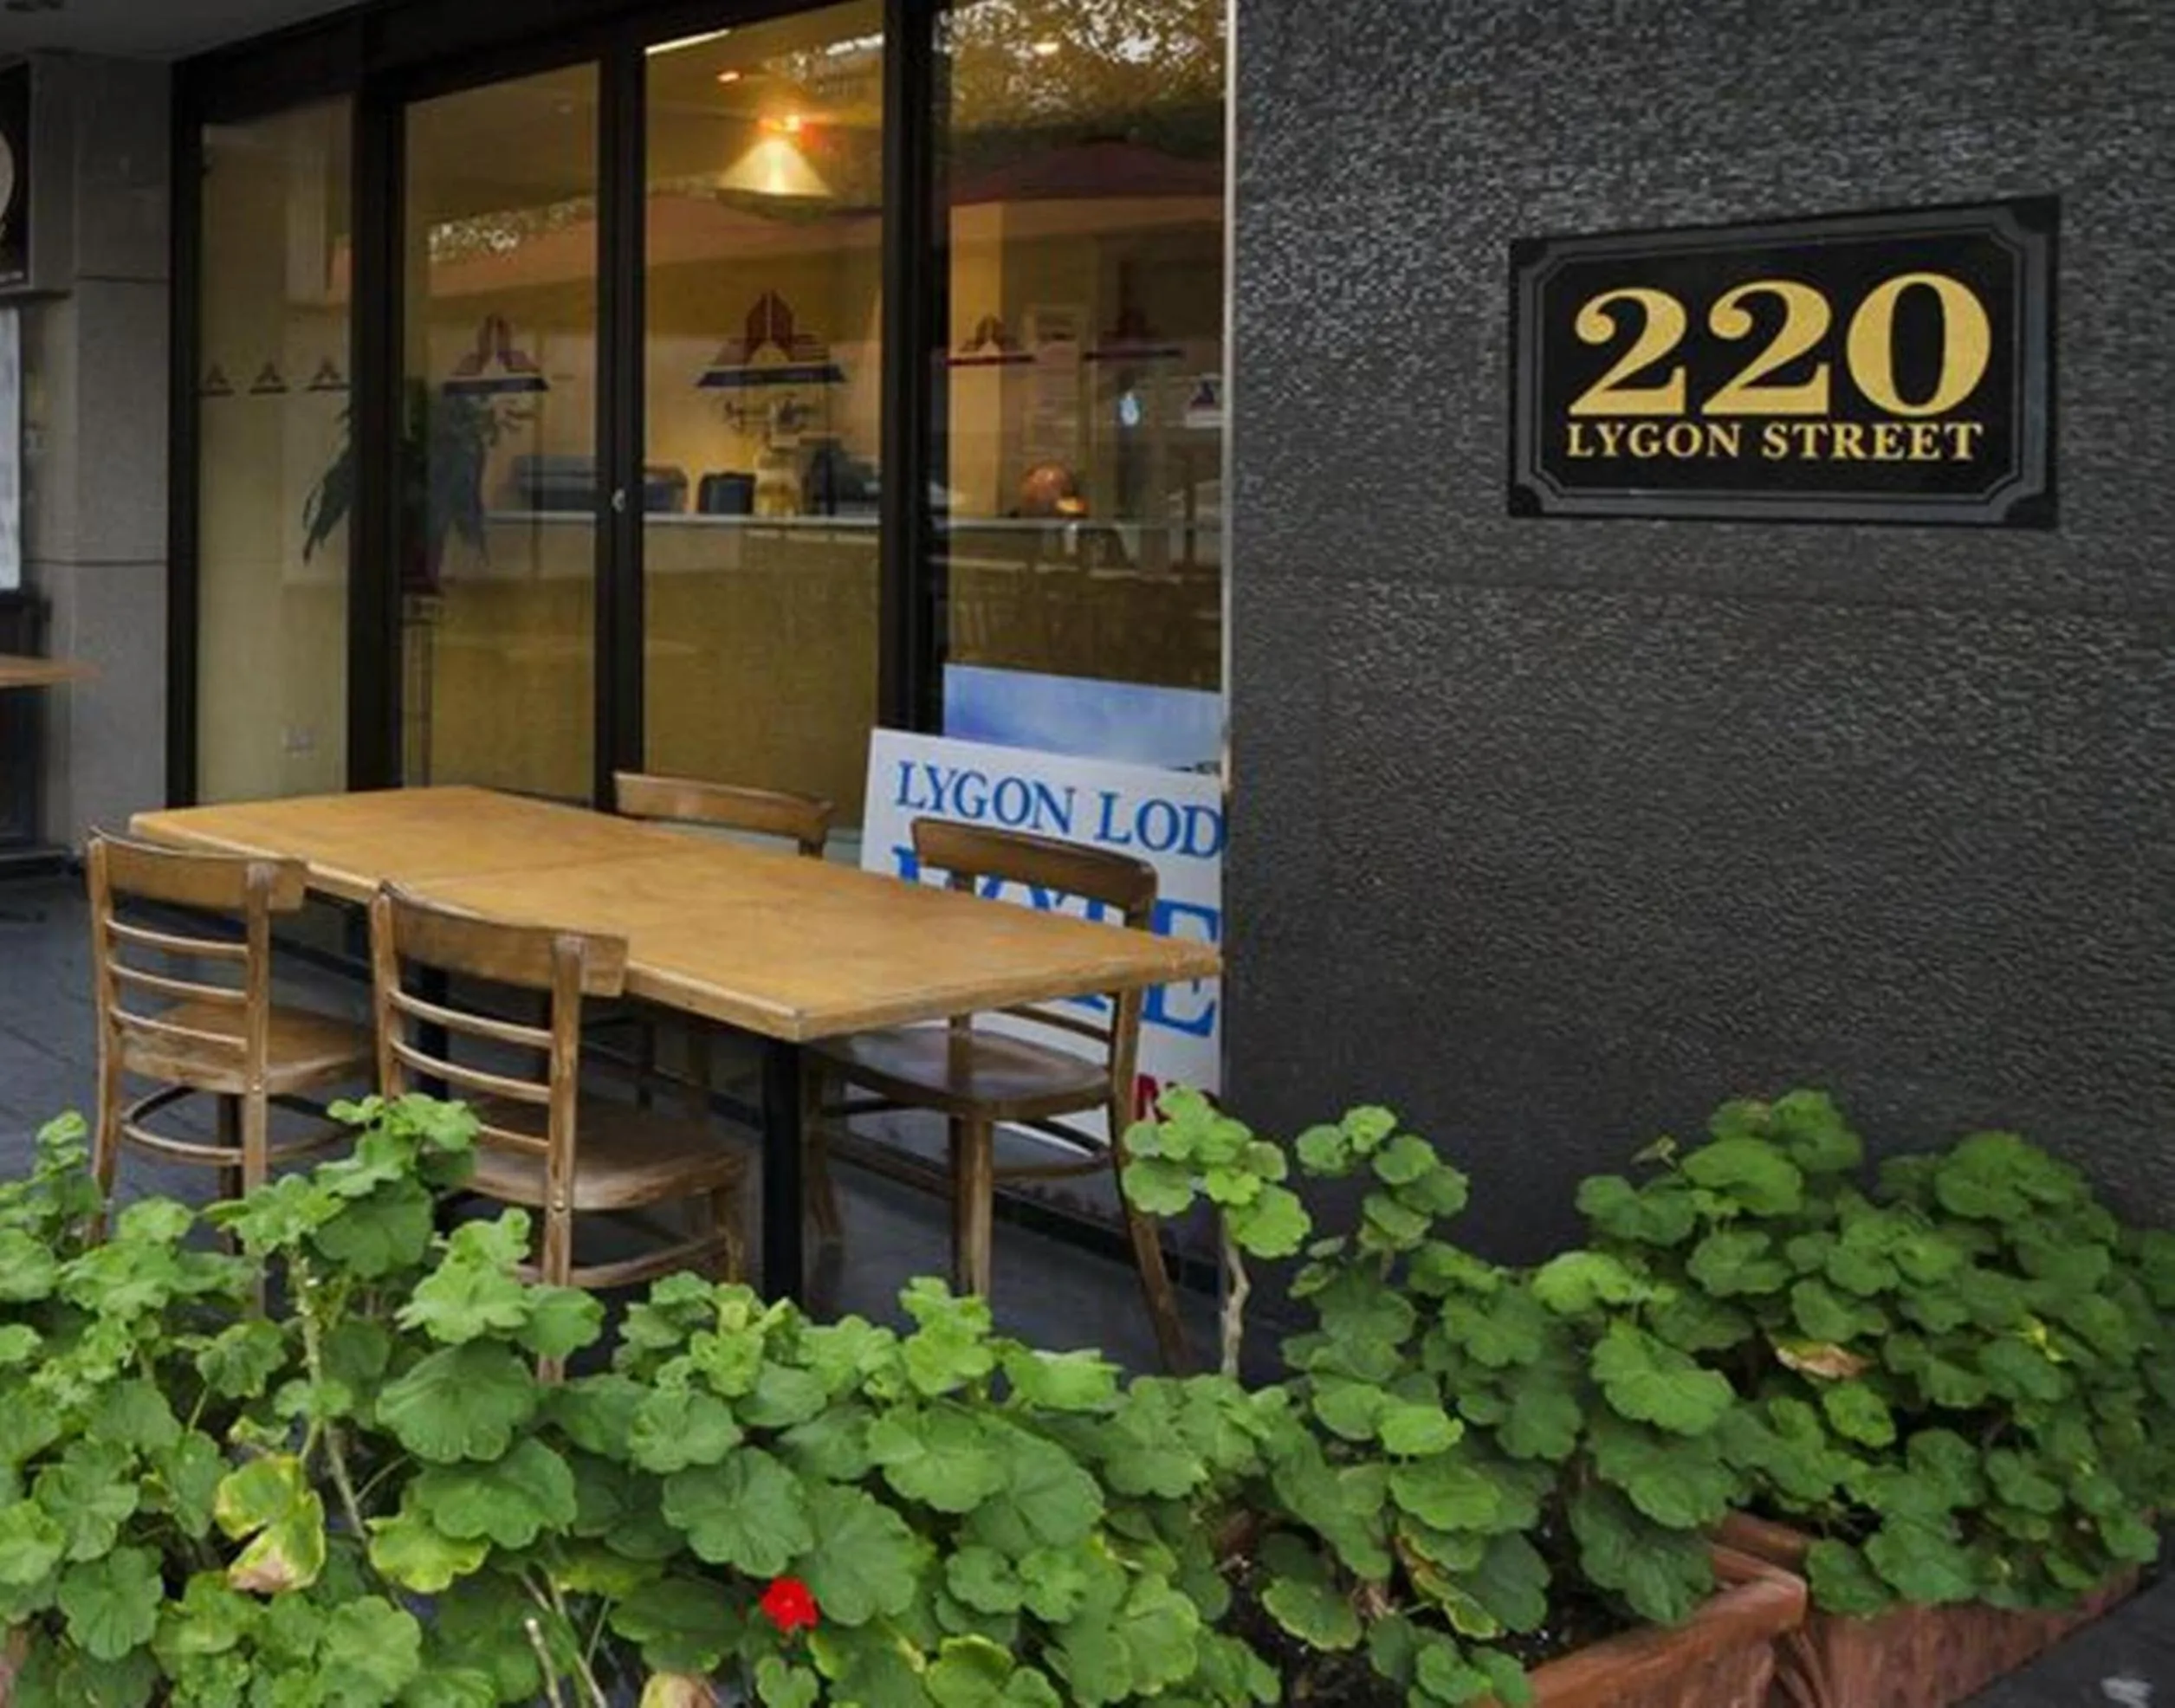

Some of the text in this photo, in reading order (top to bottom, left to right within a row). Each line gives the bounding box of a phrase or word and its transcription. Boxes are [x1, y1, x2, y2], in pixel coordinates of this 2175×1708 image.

[1568, 271, 1991, 416] 220
[1566, 422, 1984, 461] LYGON STREET
[895, 760, 1077, 835] LYGON
